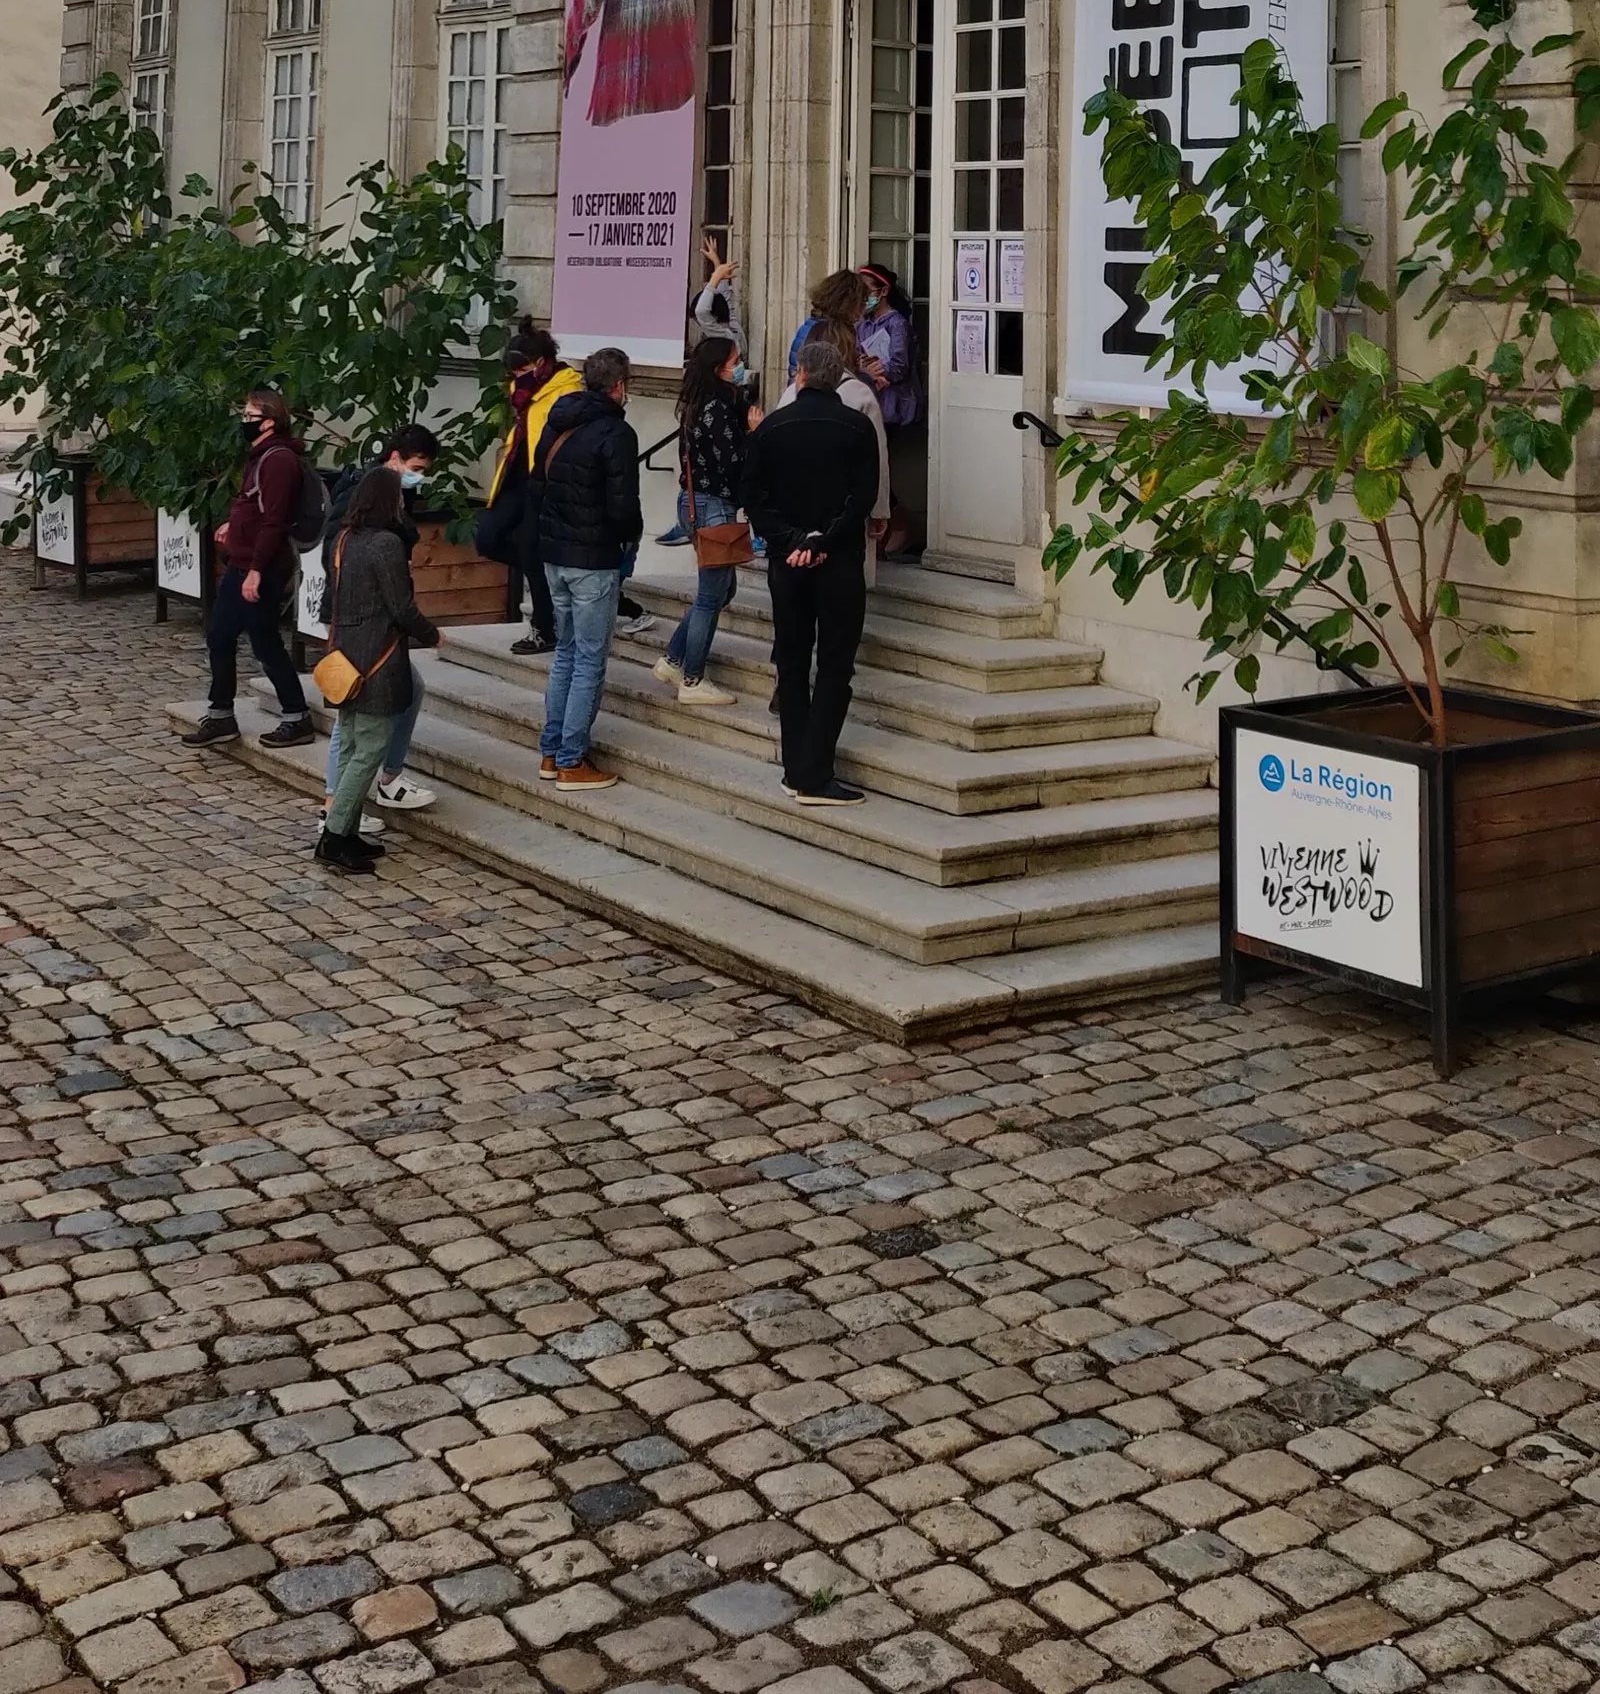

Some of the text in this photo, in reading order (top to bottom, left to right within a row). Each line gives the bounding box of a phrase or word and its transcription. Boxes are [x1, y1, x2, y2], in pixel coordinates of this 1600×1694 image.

[572, 191, 677, 217] 10 SEPTEMBRE 2020
[588, 223, 600, 246] 17
[601, 222, 644, 246] JANVIER
[646, 222, 674, 246] 2021
[1290, 758, 1393, 802] La Région
[1291, 787, 1393, 821] Auvergne-Rhône-Alpes
[1260, 840, 1349, 879] VIVIENNE
[1262, 871, 1394, 923] WESTWOOD
